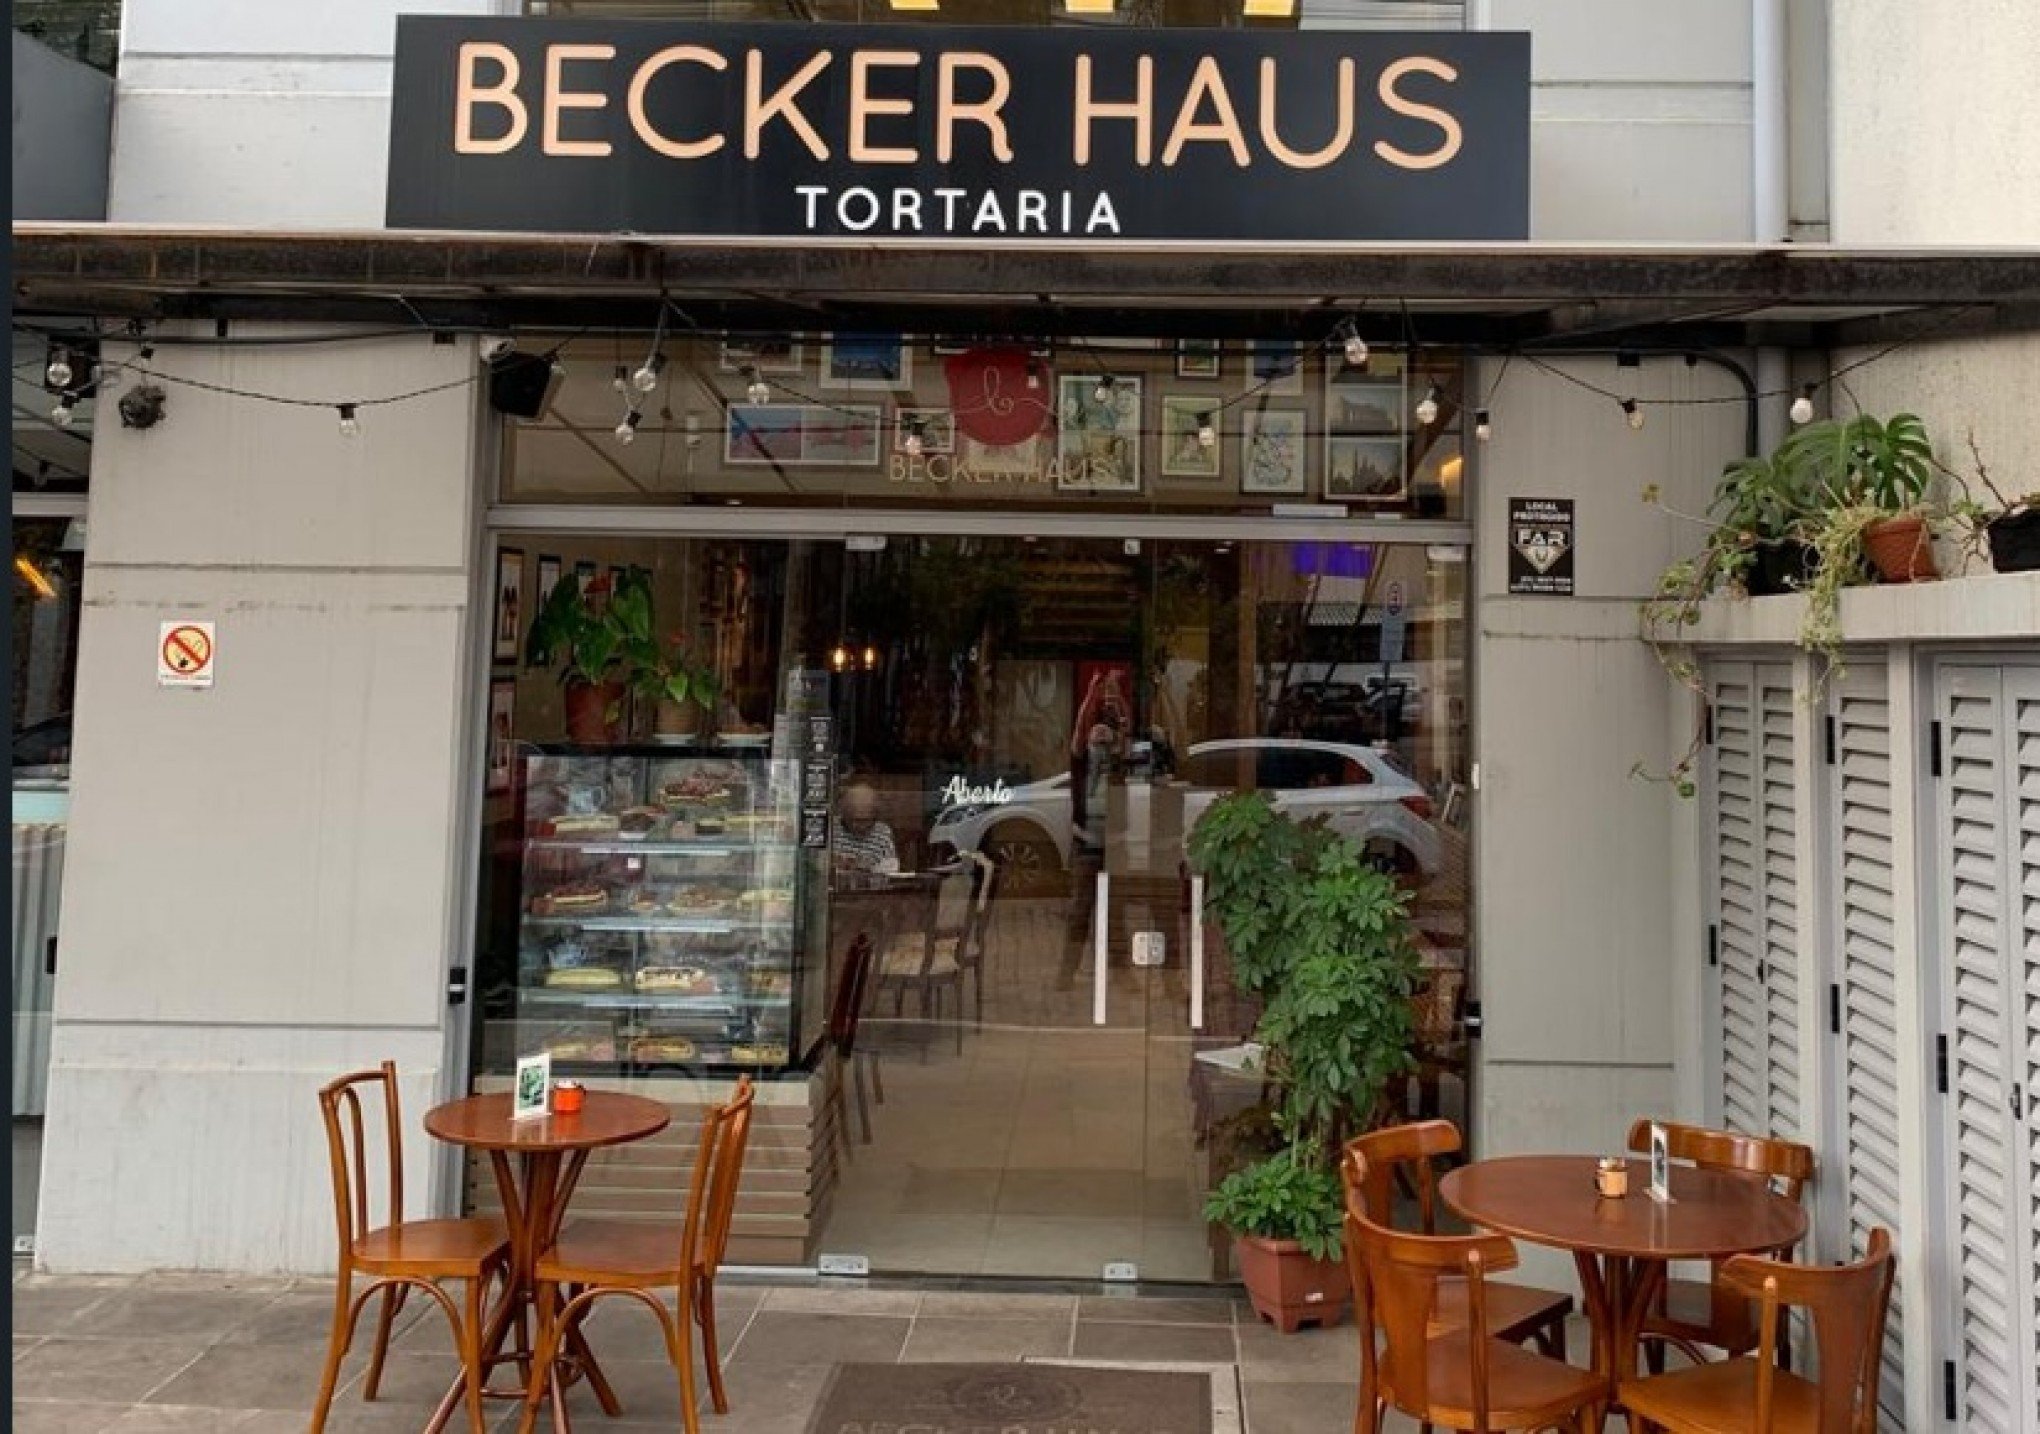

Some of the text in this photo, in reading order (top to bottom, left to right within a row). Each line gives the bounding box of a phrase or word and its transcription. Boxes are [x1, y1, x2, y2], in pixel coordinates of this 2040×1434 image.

[454, 42, 1463, 168] BECKER HAUS
[796, 187, 1121, 233] TORTARIA
[940, 774, 1013, 805] Aberto
